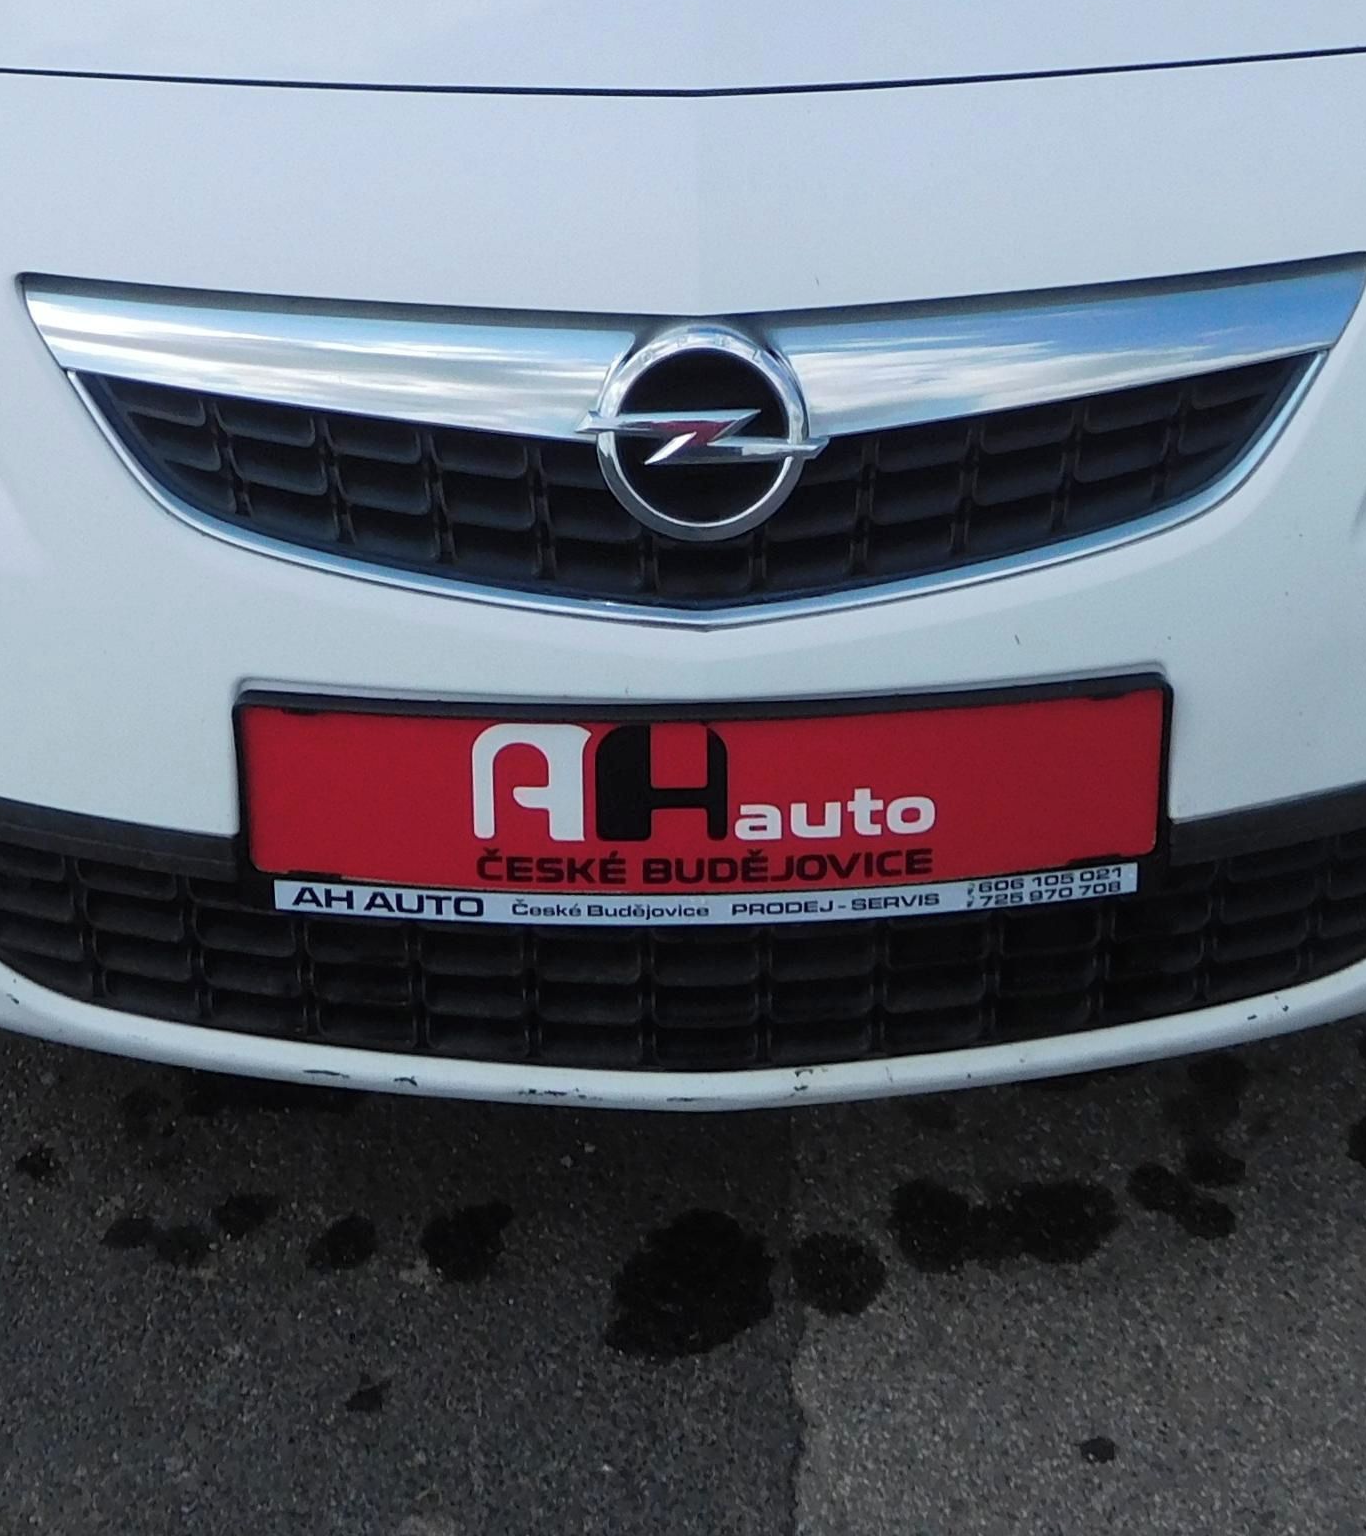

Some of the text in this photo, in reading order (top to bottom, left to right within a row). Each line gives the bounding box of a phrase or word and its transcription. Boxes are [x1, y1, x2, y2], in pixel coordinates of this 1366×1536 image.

[476, 847, 933, 884] ČESKÉ BUDĚJOVICE
[978, 867, 1122, 893] 606 105 021
[292, 886, 355, 910] AH
[364, 891, 485, 916] AUTO
[511, 898, 582, 917] České
[586, 903, 710, 921] Budějovice
[979, 880, 1121, 907] 725 970 708
